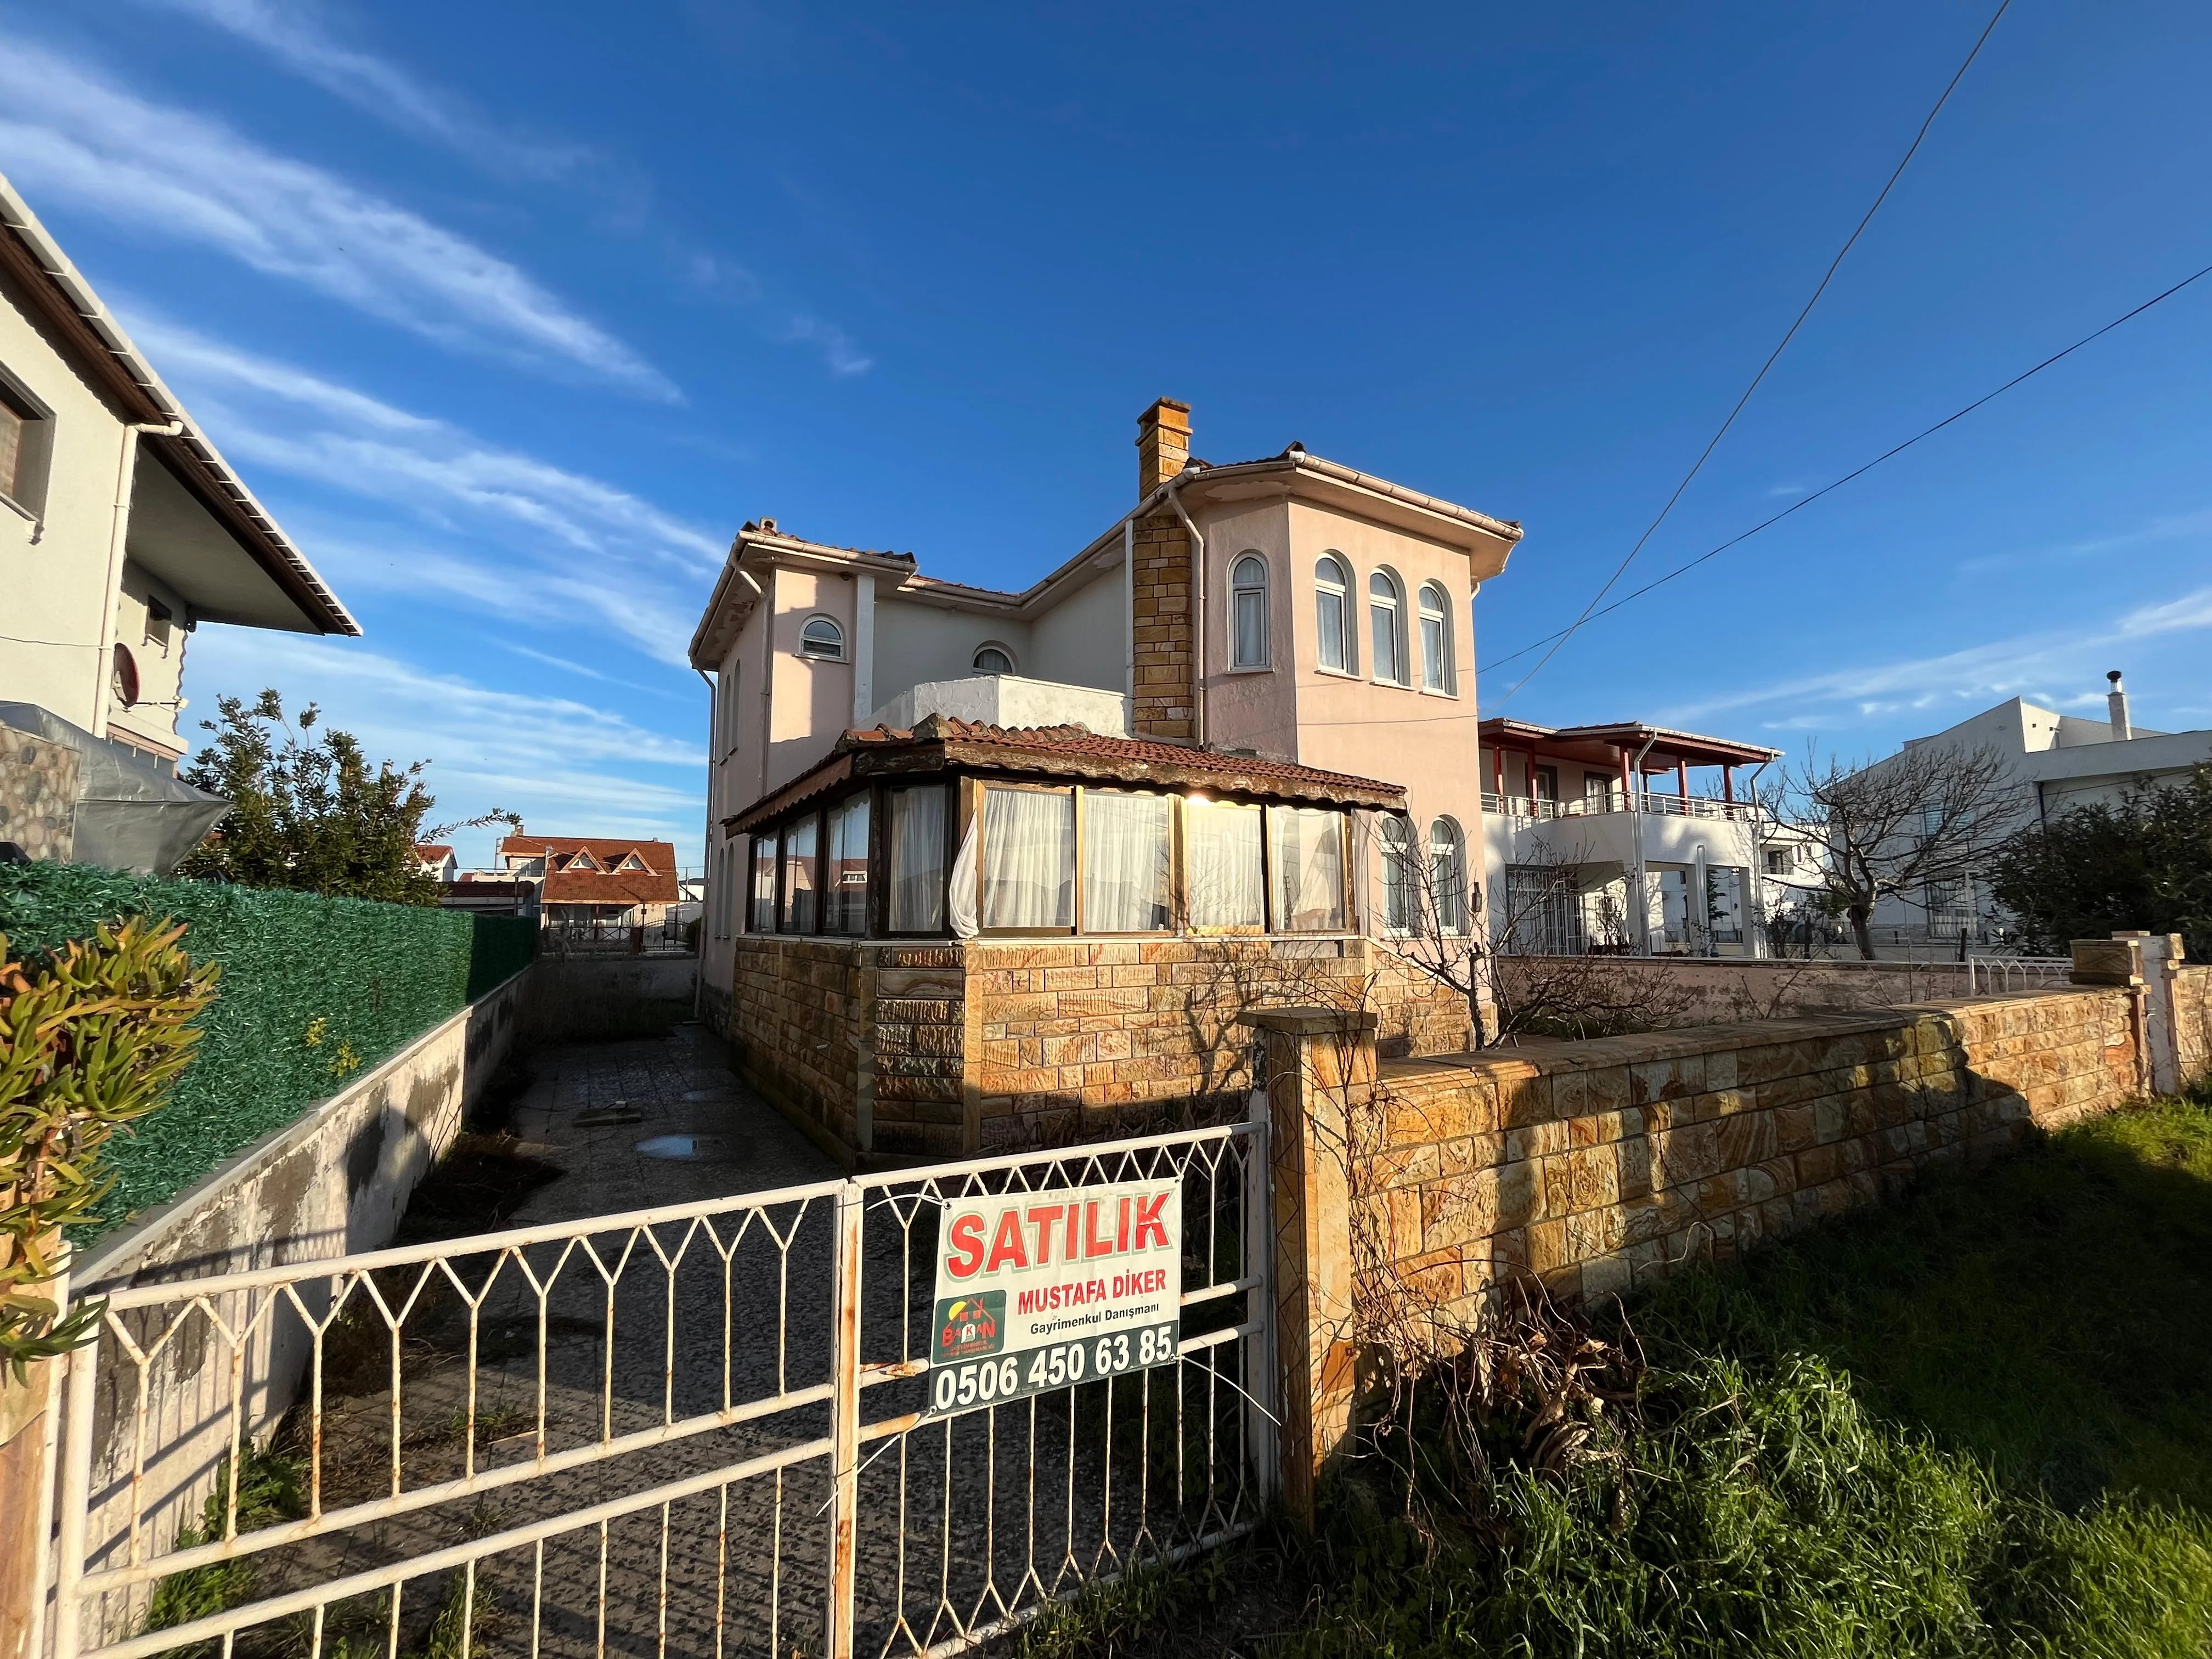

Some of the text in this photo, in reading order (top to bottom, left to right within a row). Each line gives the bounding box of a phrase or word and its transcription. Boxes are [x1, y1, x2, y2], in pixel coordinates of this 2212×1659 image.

[944, 1190, 1173, 1281] SATILIK
[1018, 1269, 1166, 1315] MUSTAFA DİKER
[1030, 1304, 1159, 1335] Gayrimenkul Danışmanı
[935, 1325, 1172, 1410] 0506 450 63 85
